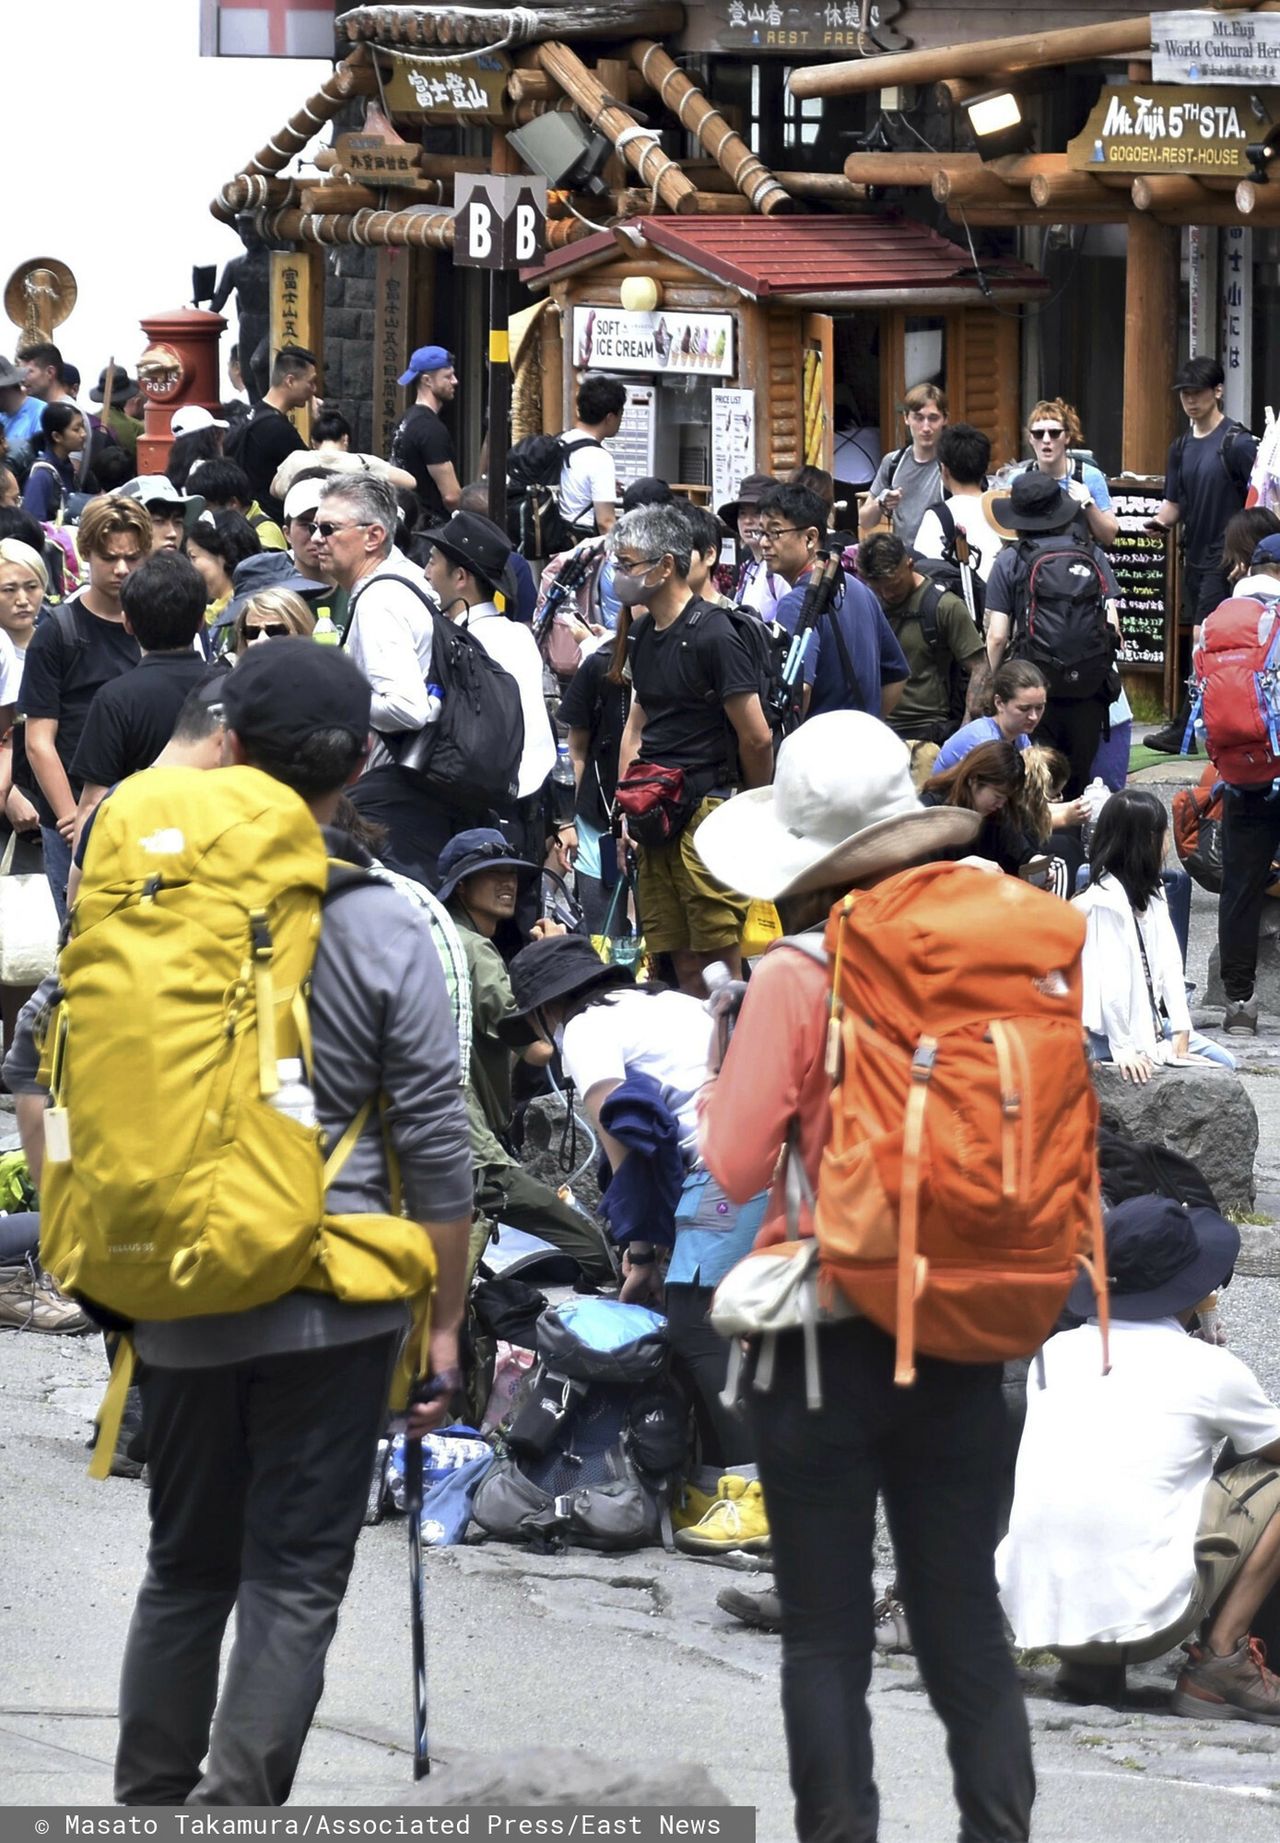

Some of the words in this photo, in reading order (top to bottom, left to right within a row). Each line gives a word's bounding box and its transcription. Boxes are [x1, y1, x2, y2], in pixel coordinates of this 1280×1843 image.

[766, 31, 809, 44] REST
[823, 31, 865, 45] FREE
[1165, 39, 1202, 58] World
[1204, 40, 1254, 58] Cultural
[1257, 41, 1280, 59] Her
[407, 69, 488, 109] 富士登山
[1199, 105, 1246, 139] STA.
[1109, 145, 1239, 165] GOGOEN-REST-HOUSE
[469, 202, 492, 259] B
[516, 204, 536, 260] B
[596, 320, 621, 336] SOFT
[596, 338, 613, 357] ICE
[615, 338, 655, 359] CREAM
[146, 382, 172, 392] POST
